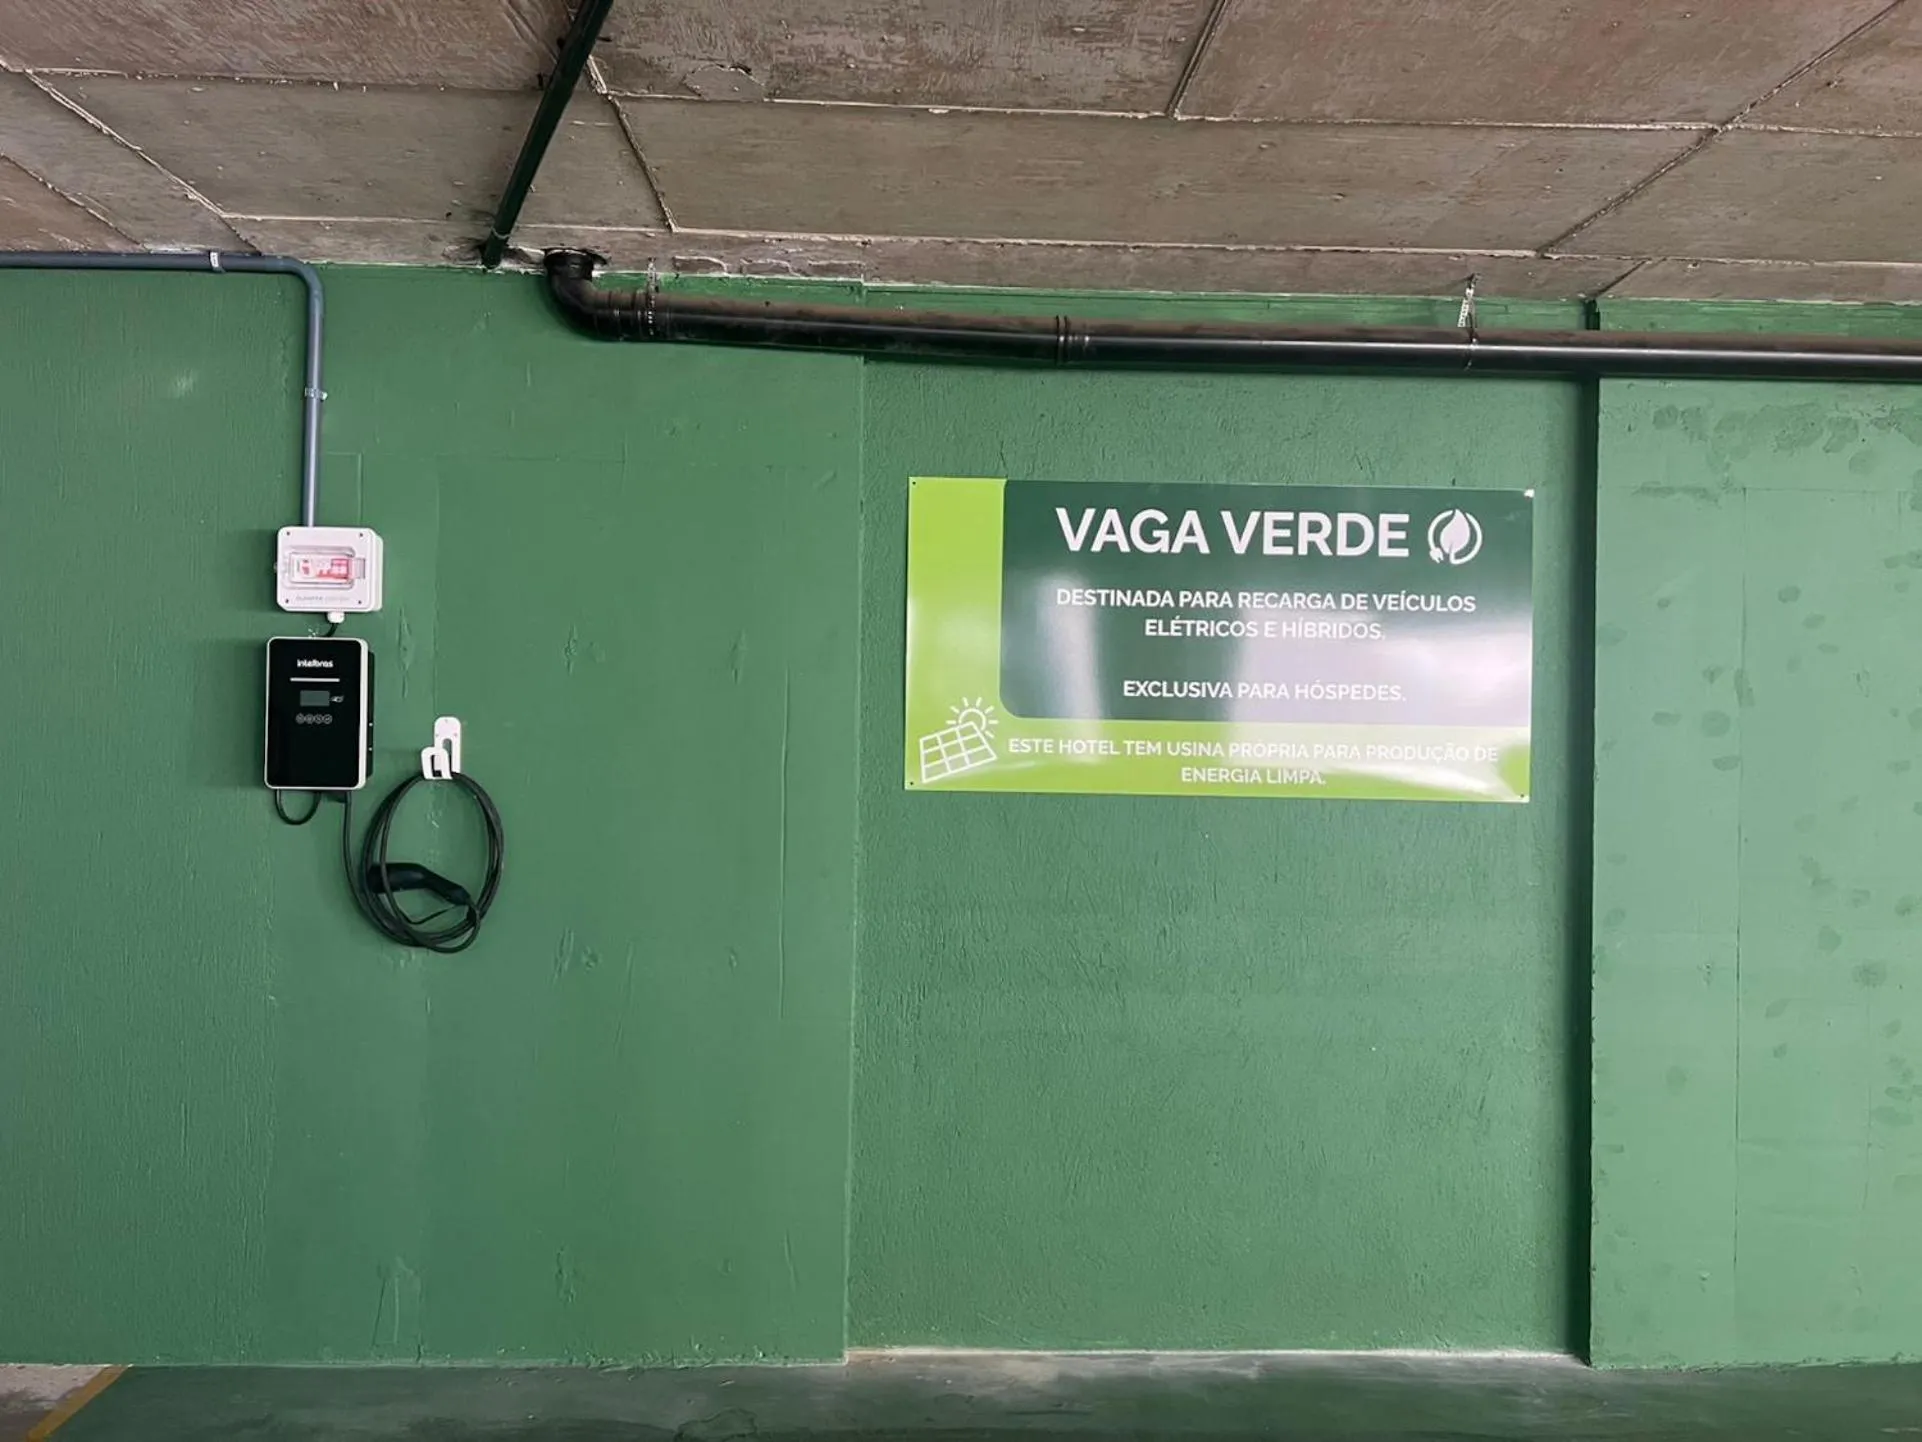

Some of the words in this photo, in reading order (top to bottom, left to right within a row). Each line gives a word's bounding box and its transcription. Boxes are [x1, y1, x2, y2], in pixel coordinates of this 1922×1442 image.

[1056, 506, 1210, 555] VAGA
[1219, 509, 1410, 558] VERDE
[1056, 588, 1175, 608] DESTINADA
[1179, 590, 1234, 609] PARA
[1239, 591, 1337, 611] RECARGA
[1341, 593, 1368, 611] DE
[1372, 590, 1477, 612] VEÍCULOS
[1145, 615, 1259, 638] ELÉTRICOS
[1264, 620, 1277, 638] E
[1282, 617, 1386, 640] HÍBRIDOS.
[1123, 680, 1233, 699] EXCLUSIVA
[1239, 682, 1291, 700] PARA
[1296, 677, 1407, 702] HÓSPEDES.
[1009, 738, 1054, 755] ESTE
[1059, 739, 1120, 757] HOTEL
[1124, 741, 1163, 757] TEM
[1167, 742, 1225, 760] USINA
[1313, 744, 1362, 761] PARA
[1366, 742, 1470, 765] PRODUÇÃO
[1475, 745, 1498, 762] DE
[1181, 766, 1262, 784] ENERGIA
[1266, 767, 1326, 786] LIMPA.
